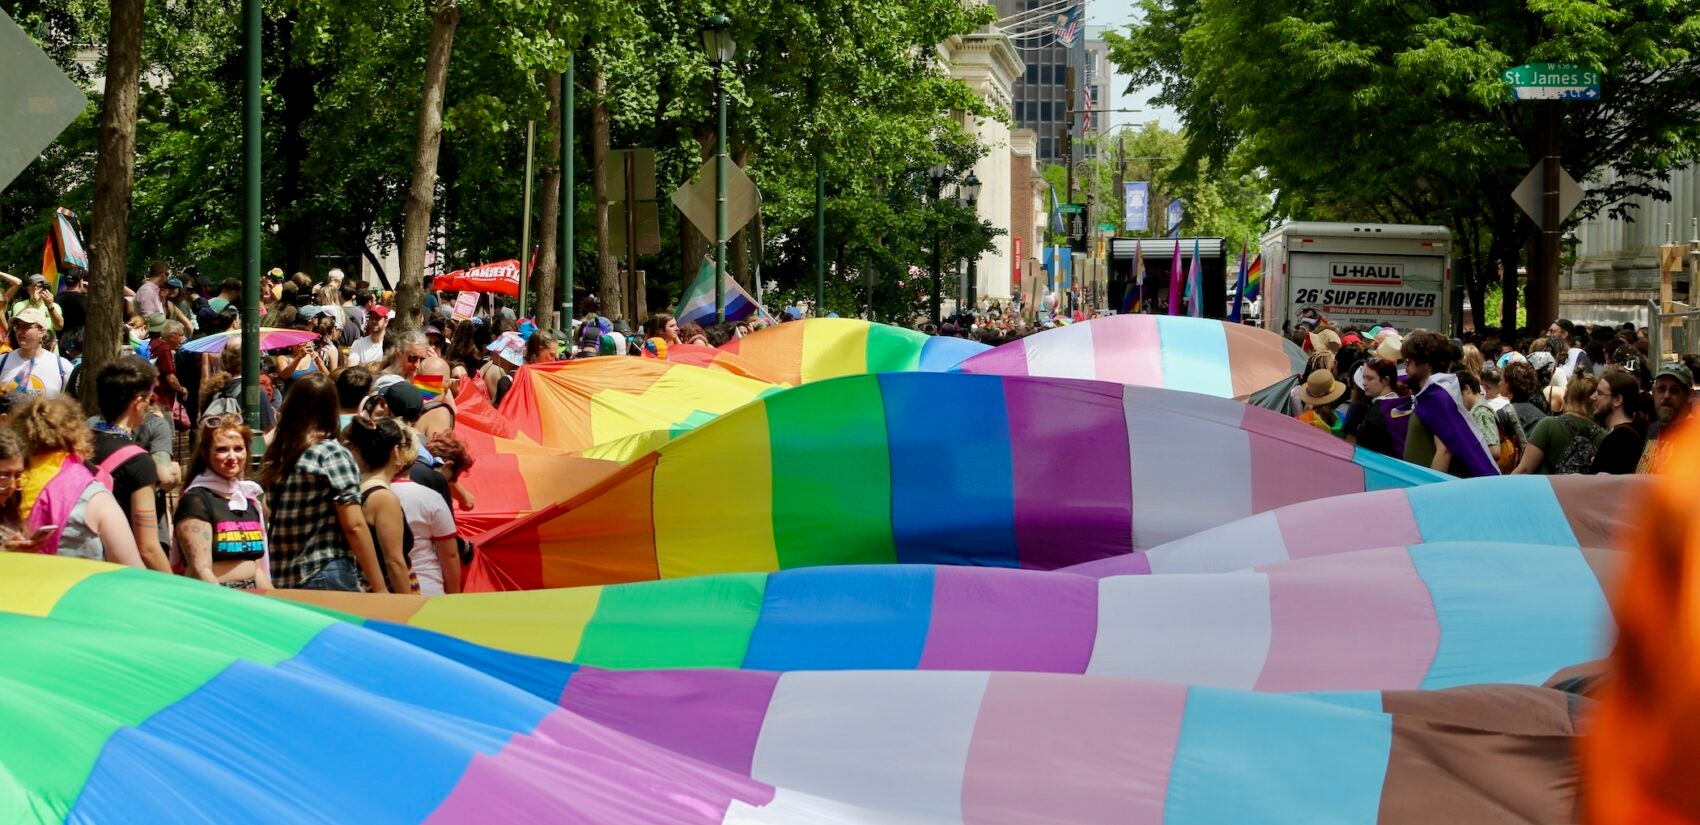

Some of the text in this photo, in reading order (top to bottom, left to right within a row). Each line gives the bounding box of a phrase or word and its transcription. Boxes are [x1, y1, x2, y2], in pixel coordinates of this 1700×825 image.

[1505, 71, 1597, 85] St. James St
[1333, 264, 1401, 279] U-HAUL
[1295, 288, 1437, 308] 26' SUPERMOVER
